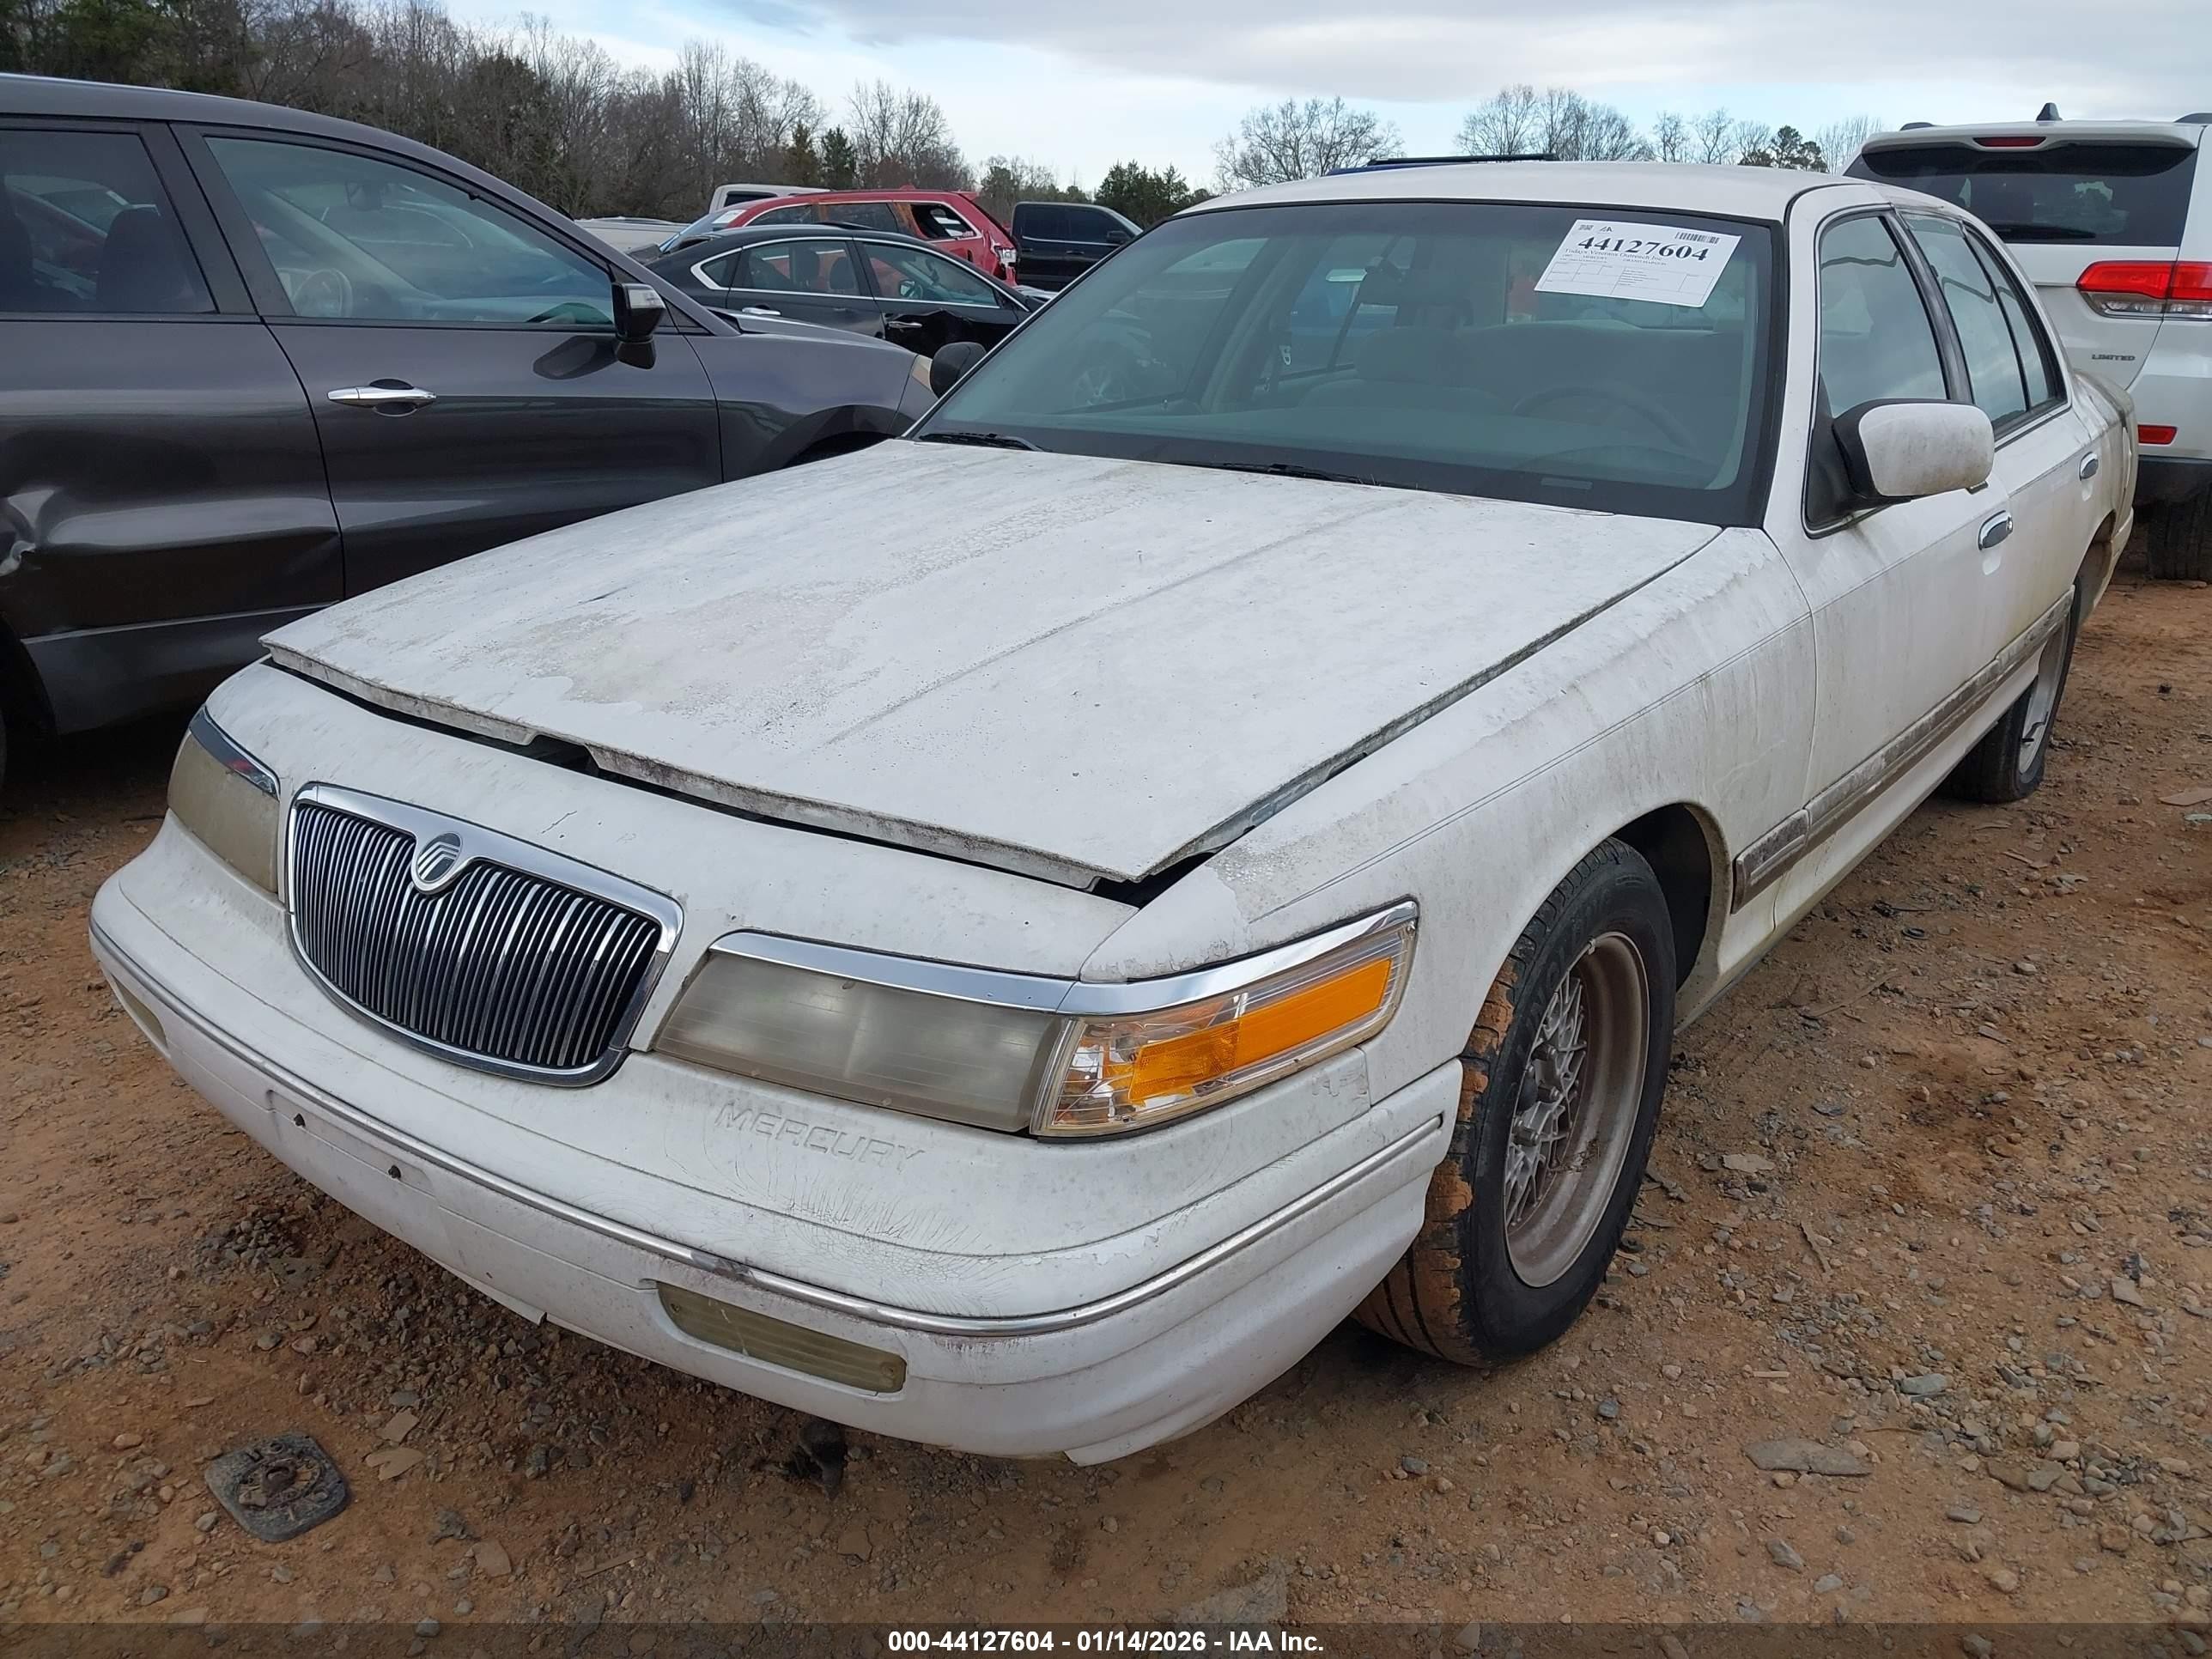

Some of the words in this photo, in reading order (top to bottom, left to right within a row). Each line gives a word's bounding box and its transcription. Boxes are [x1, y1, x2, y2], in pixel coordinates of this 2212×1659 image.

[1578, 236, 1709, 261] 44127604
[2091, 353, 2136, 362] LIMITED
[714, 1101, 926, 1174] MERCURY
